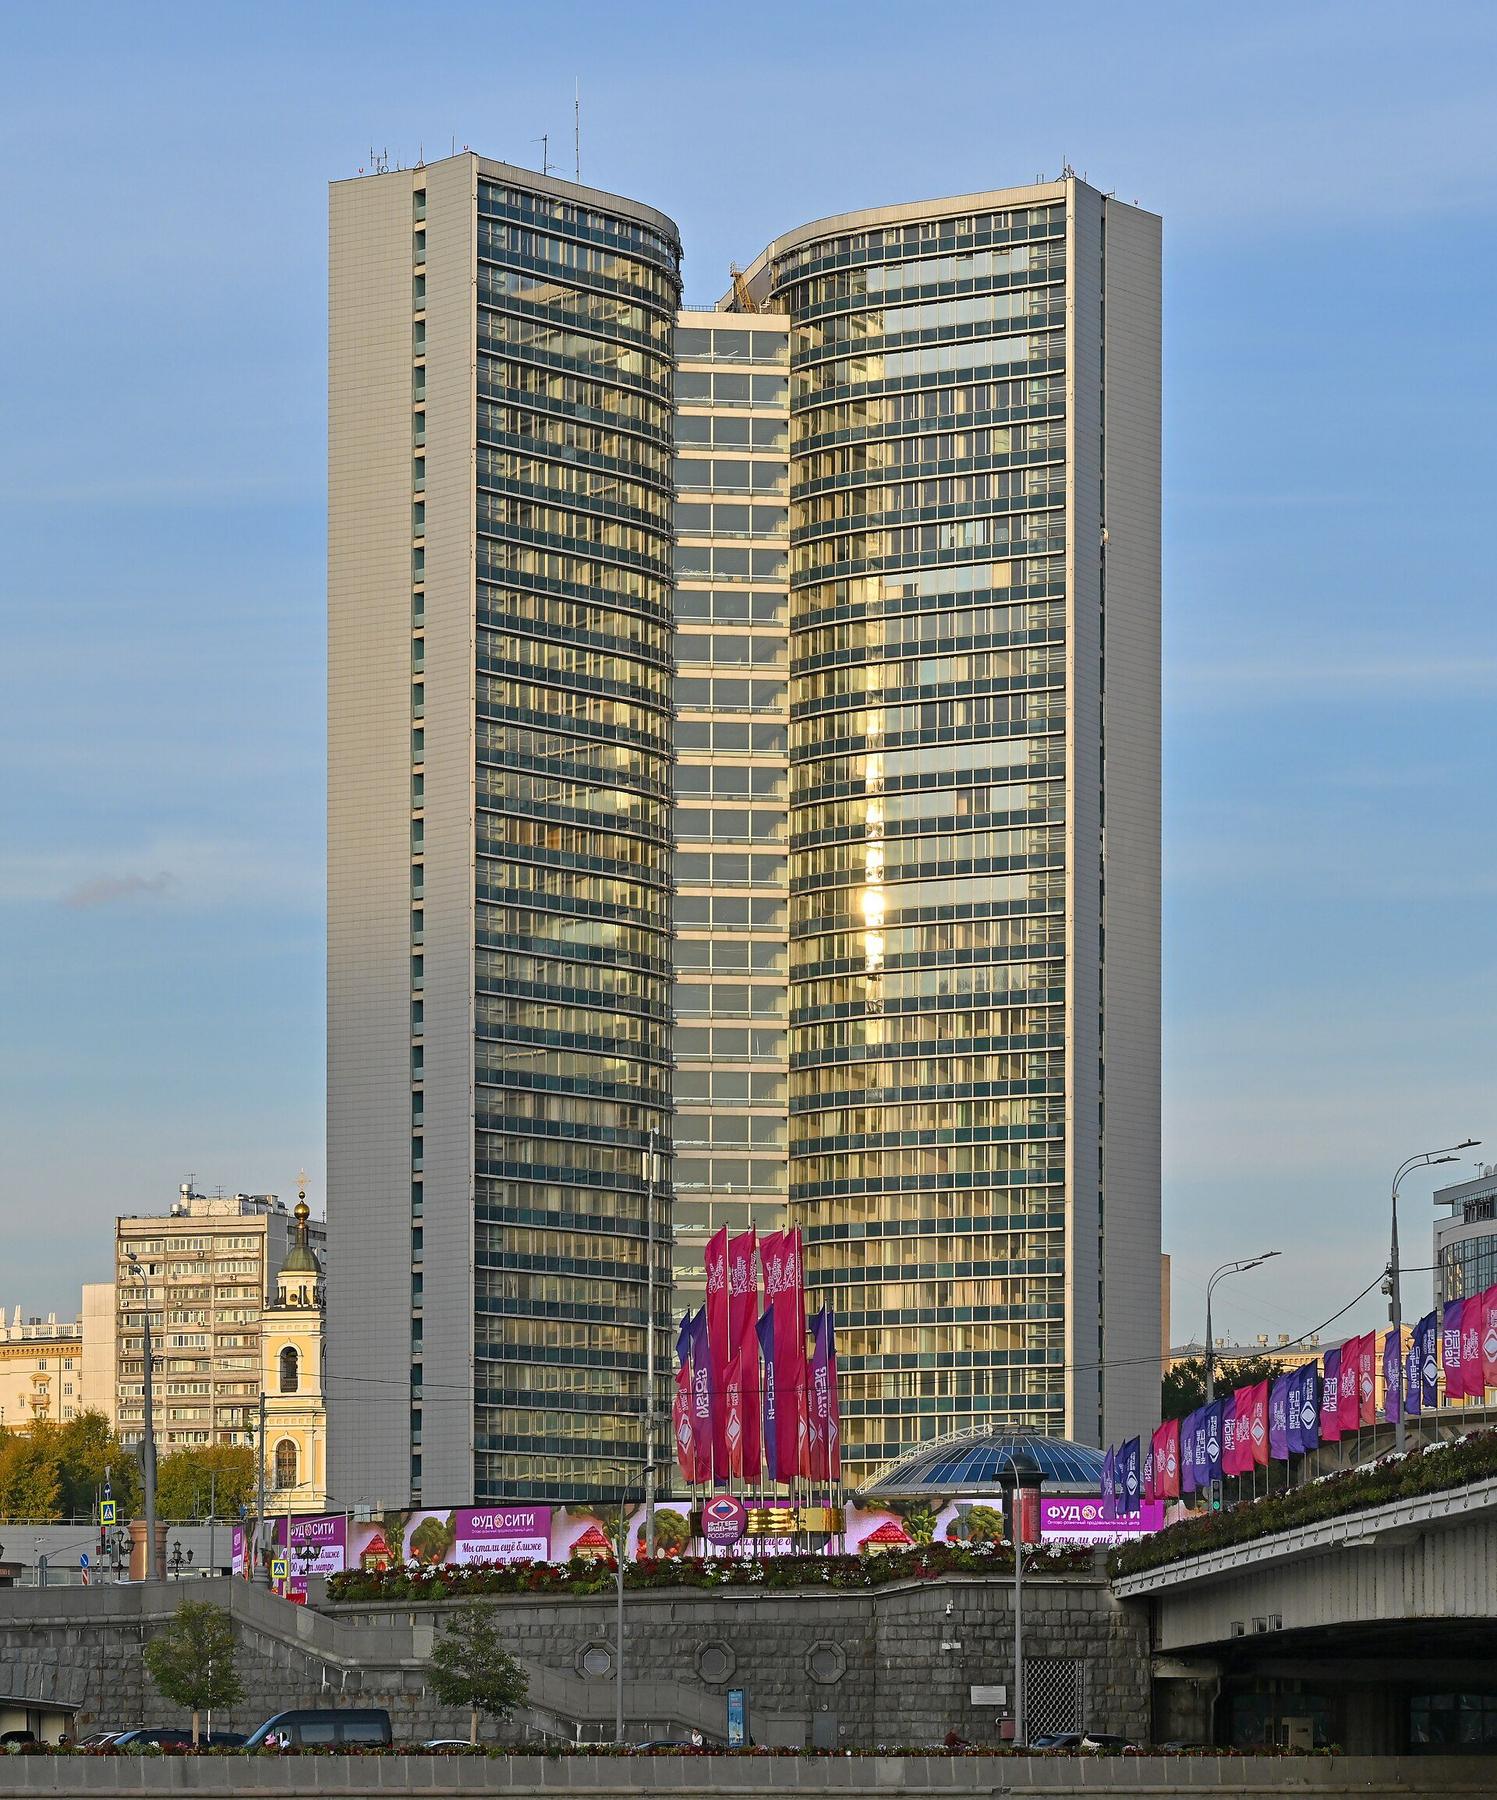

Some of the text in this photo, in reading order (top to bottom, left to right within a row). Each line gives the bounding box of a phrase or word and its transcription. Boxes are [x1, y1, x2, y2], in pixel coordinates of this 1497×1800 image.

[1047, 1506, 1080, 1520] ФУД
[472, 1514, 534, 1529] ФУД СИТИ
[312, 1523, 334, 1535] СИТИ
[462, 1541, 542, 1554] Мы стали ещё ближе
[469, 1555, 484, 1564] 300
